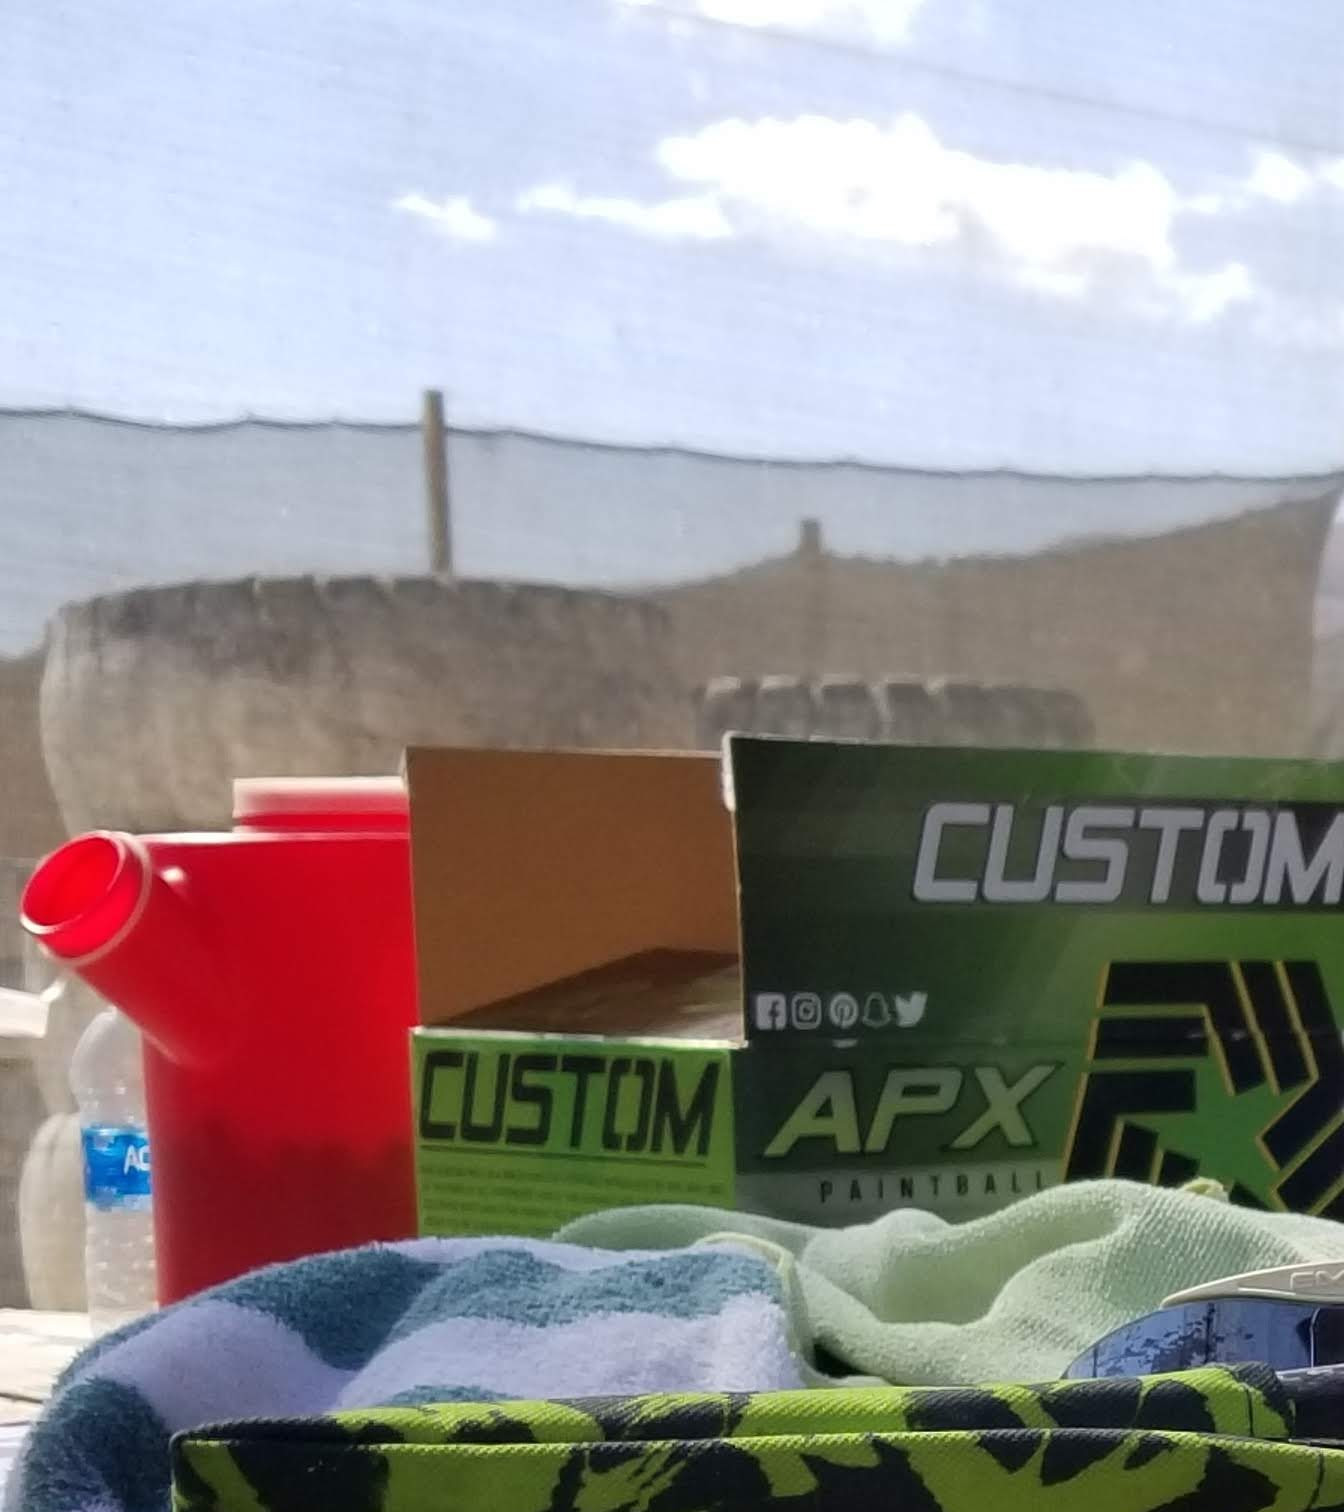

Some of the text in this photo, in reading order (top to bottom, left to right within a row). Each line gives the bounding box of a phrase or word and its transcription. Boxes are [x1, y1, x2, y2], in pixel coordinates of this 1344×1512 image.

[420, 1051, 720, 1157] CUSTOM
[762, 1064, 1060, 1157] APX
[819, 1171, 1049, 1202] PAINTBALL
